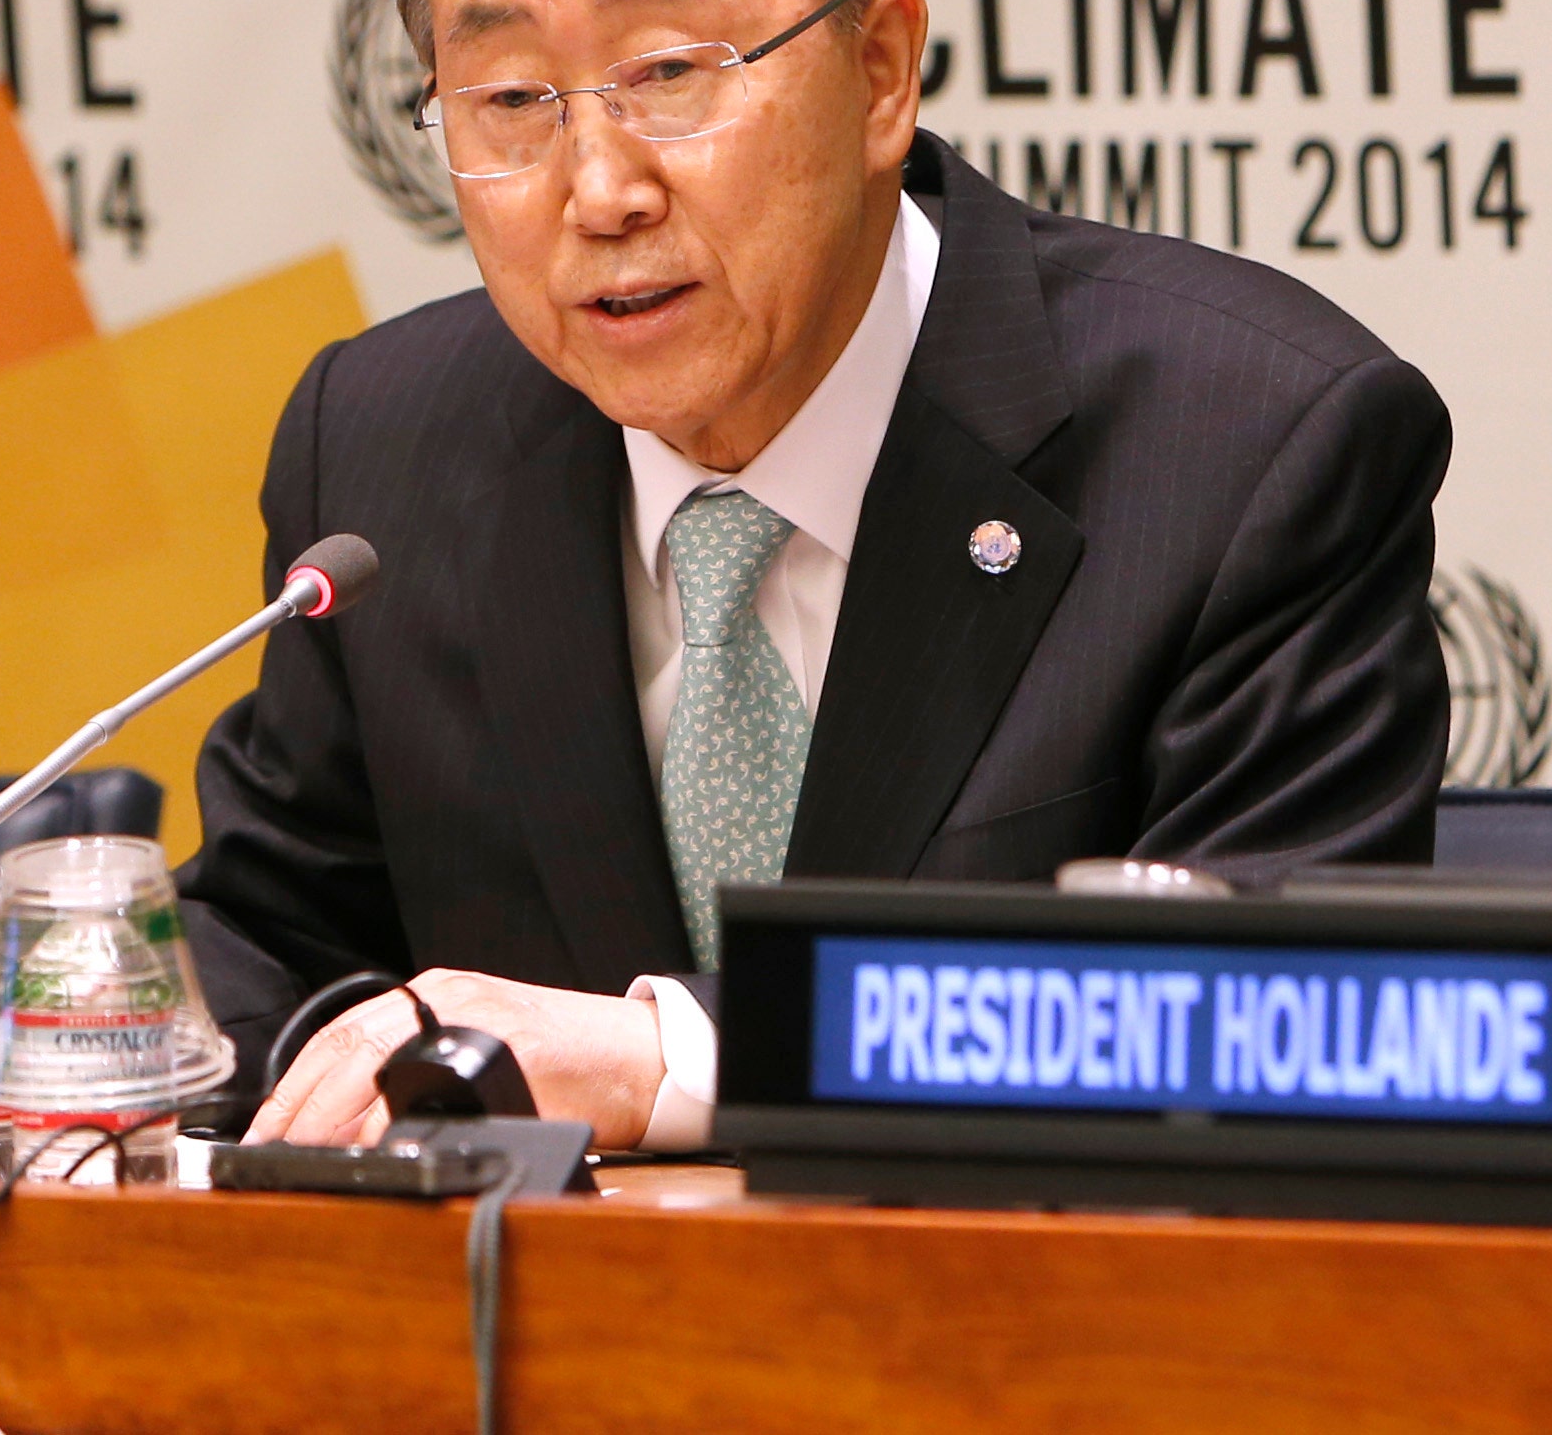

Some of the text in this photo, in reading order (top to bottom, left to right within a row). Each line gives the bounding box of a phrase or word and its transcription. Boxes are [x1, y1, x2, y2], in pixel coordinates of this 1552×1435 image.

[56, 152, 152, 256] 14
[954, 136, 1529, 250] MMIT 2014
[850, 964, 1549, 1105] PRESIDENT HOLLANDE
